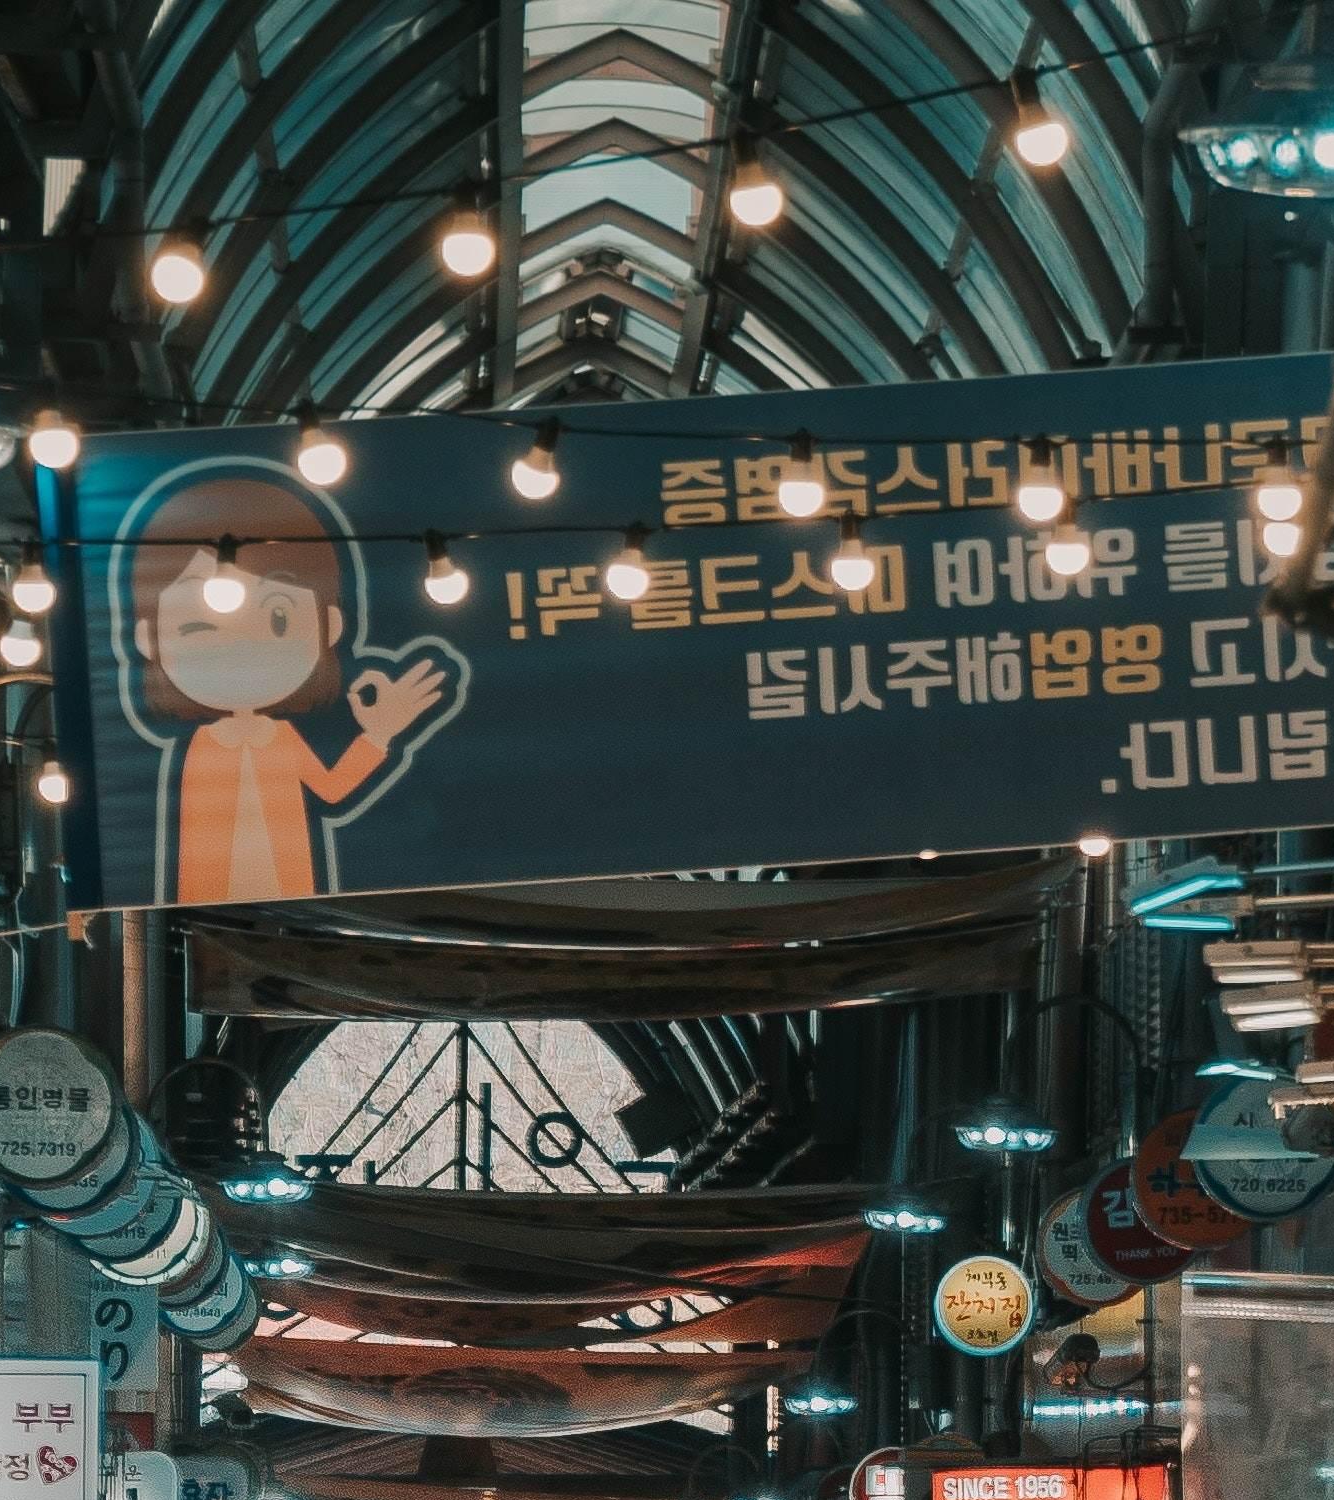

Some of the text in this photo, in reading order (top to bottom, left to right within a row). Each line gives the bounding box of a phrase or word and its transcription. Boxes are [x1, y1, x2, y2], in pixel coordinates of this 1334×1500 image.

[11, 1402, 75, 1434] 부부
[942, 1474, 1066, 1500] SINCE 1956
